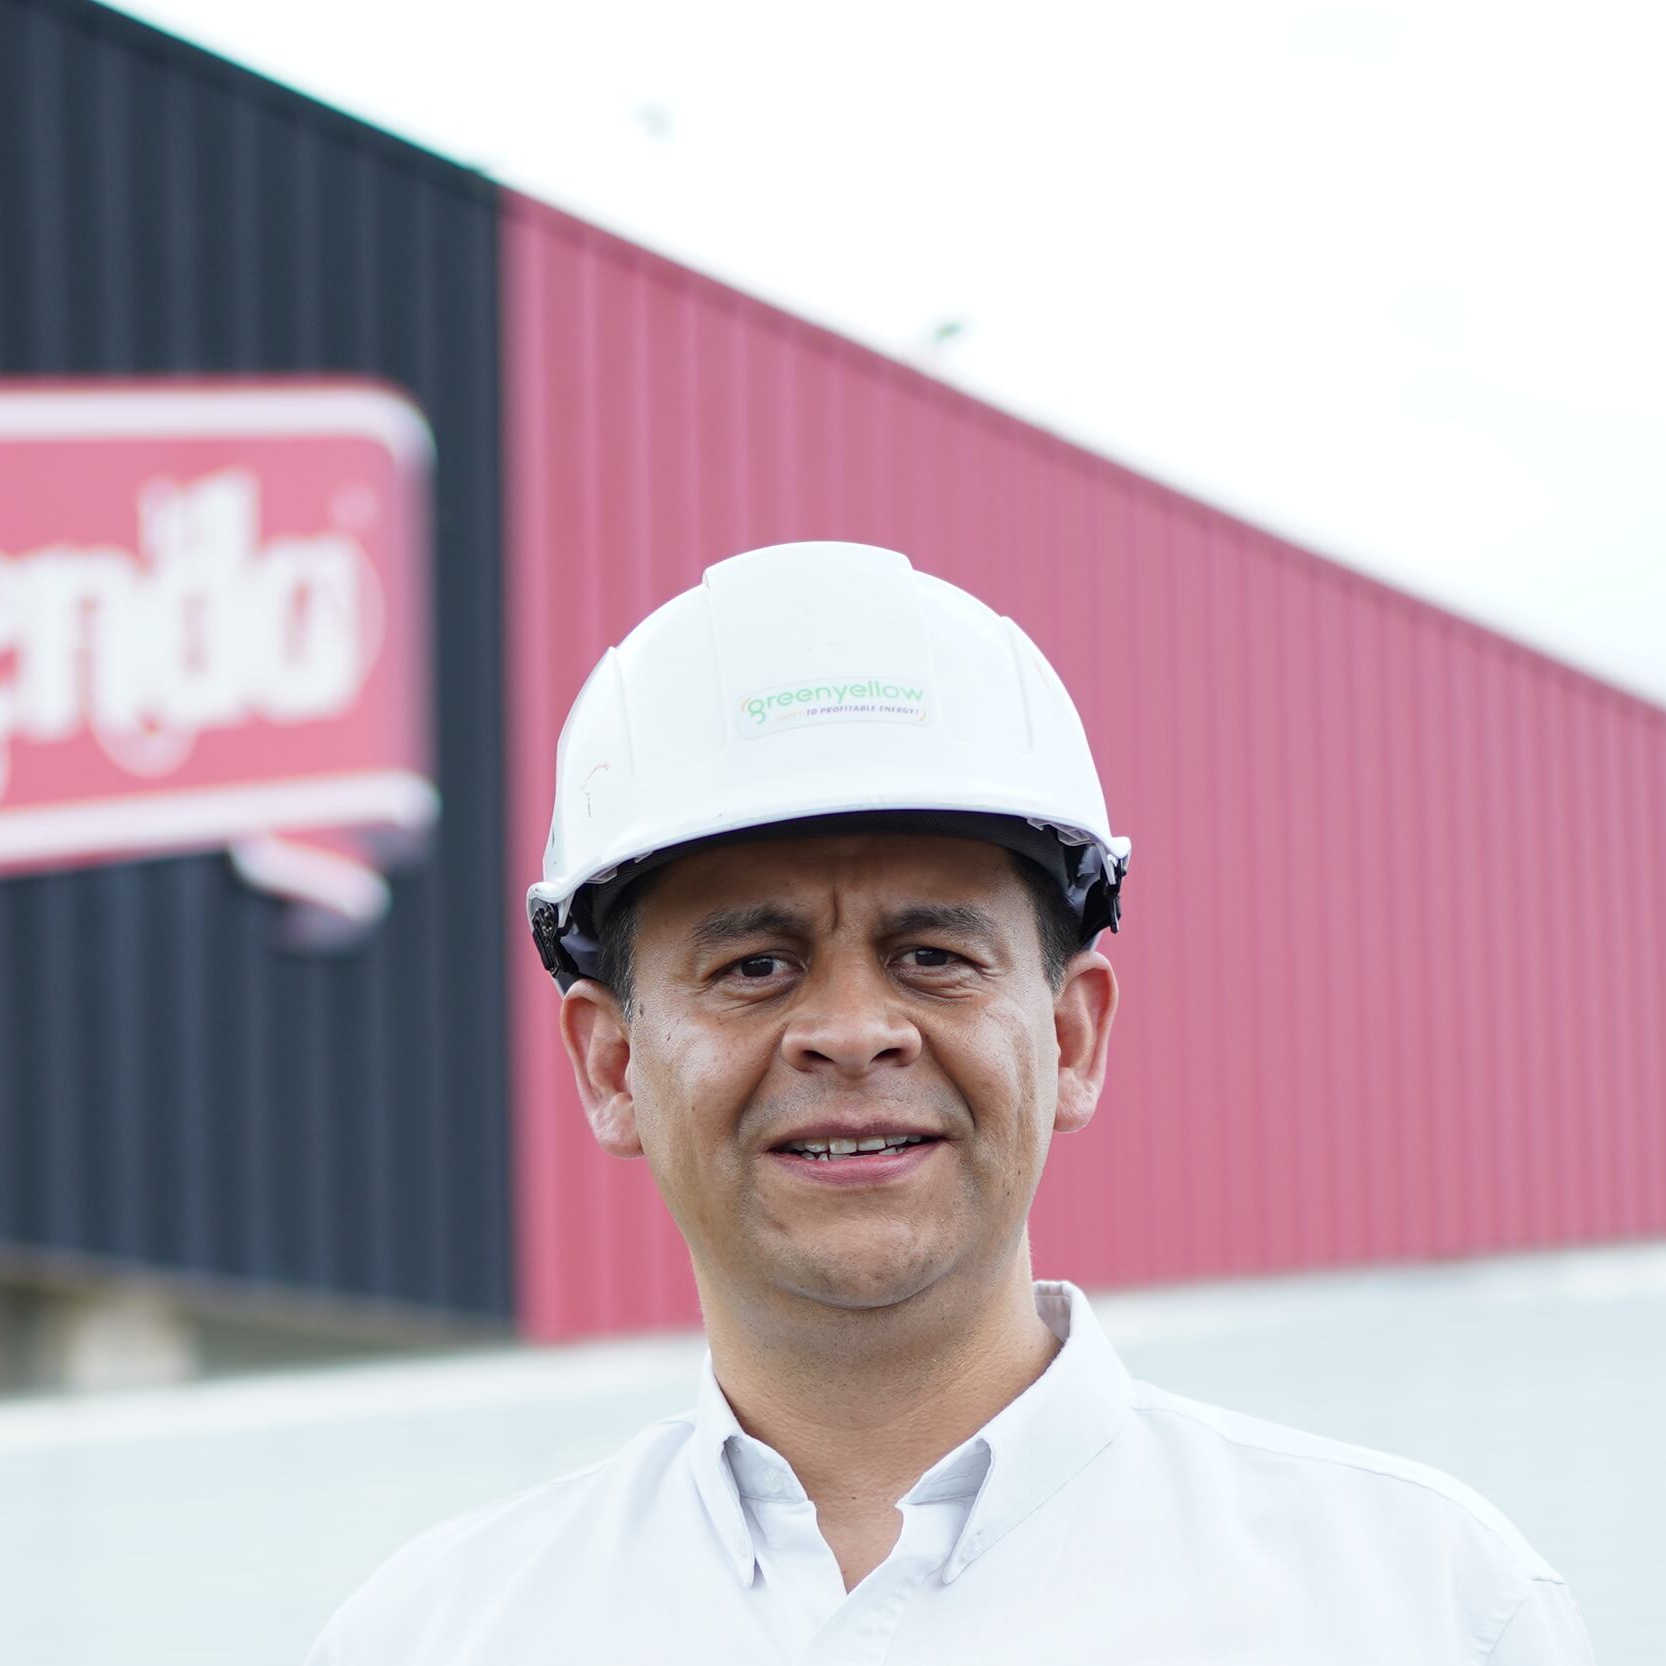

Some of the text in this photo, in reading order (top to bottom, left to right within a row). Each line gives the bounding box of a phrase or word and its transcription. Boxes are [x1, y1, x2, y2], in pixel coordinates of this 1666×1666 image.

[747, 680, 924, 725] greenyellow
[806, 708, 818, 716] TO
[820, 705, 876, 715] PROFITABLE
[879, 704, 920, 715] ENERGY!
